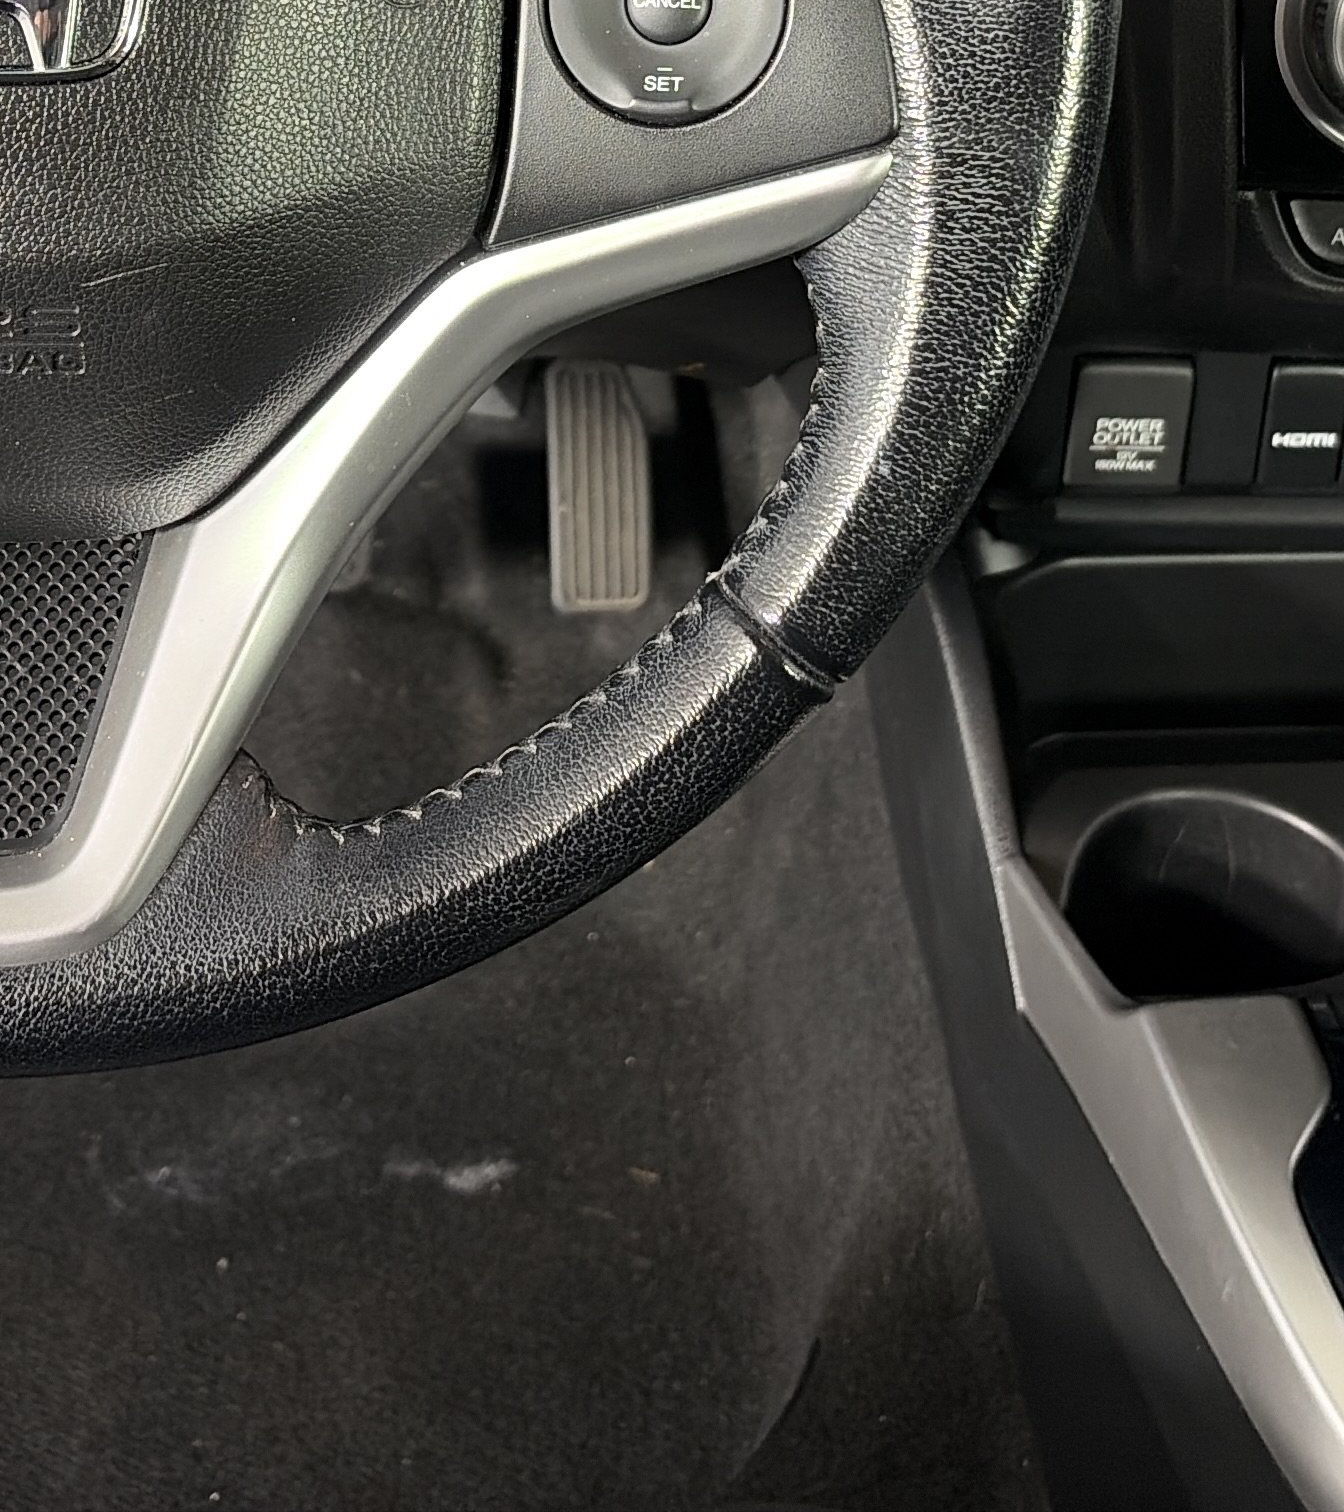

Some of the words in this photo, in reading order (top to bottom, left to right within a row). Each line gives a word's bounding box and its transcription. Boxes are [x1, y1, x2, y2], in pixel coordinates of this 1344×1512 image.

[643, 75, 685, 93] SET
[1096, 417, 1165, 432] POWER
[1092, 431, 1165, 445] OUTLET
[1271, 432, 1338, 449] HDMI
